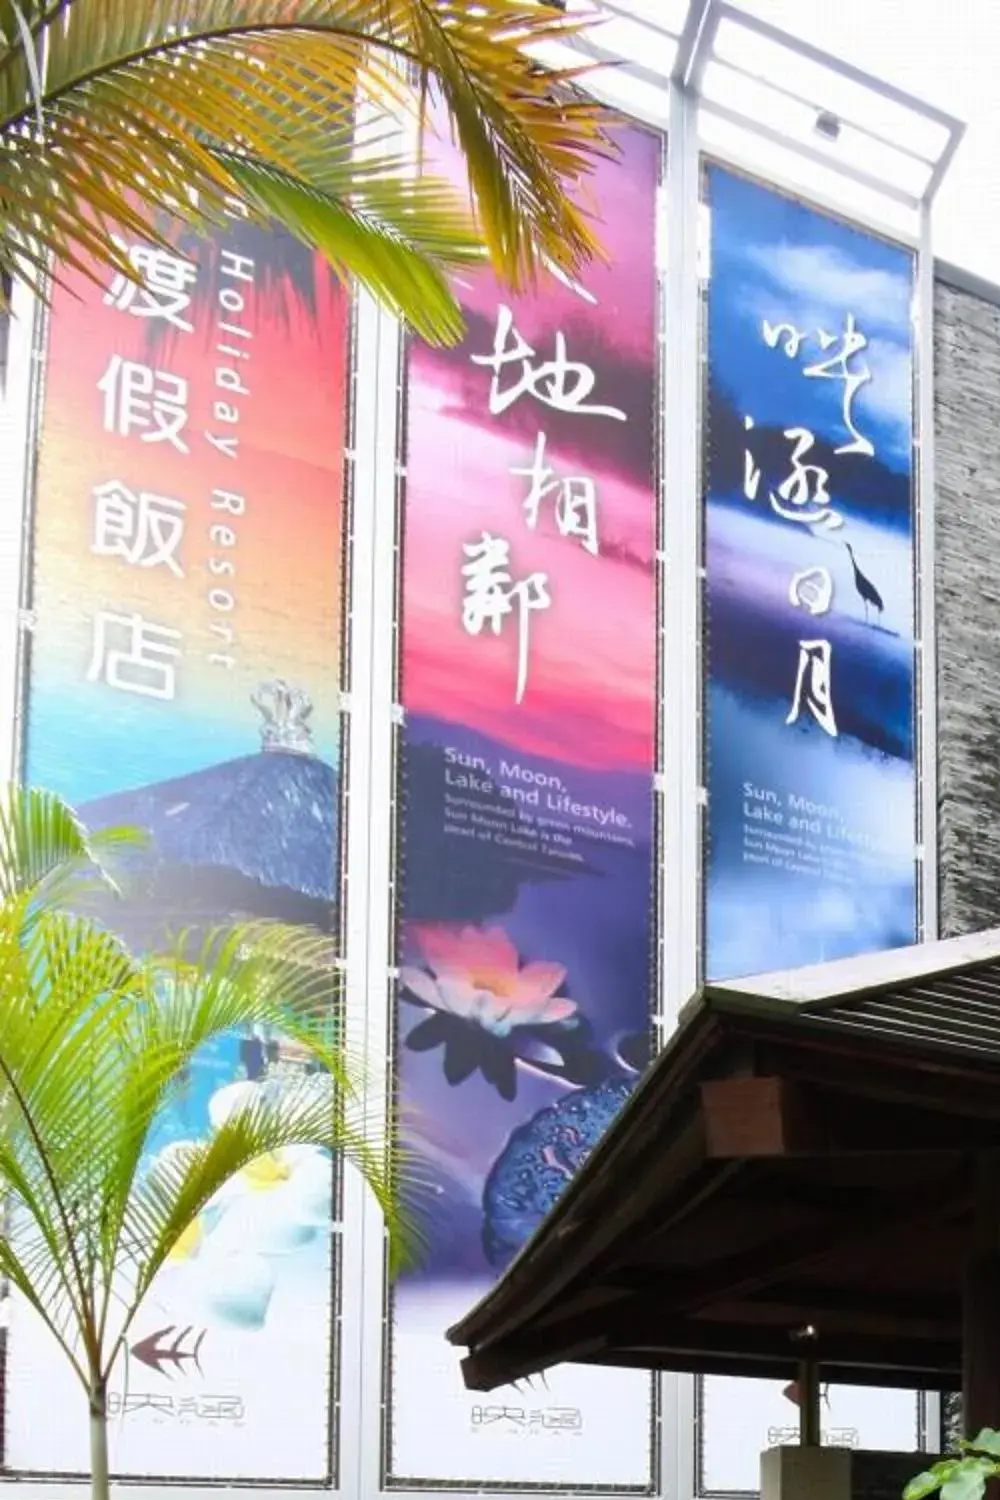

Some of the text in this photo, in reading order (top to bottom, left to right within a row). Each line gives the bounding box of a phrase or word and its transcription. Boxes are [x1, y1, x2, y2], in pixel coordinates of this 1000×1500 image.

[204, 248, 256, 461] Holiday
[456, 237, 628, 705] 地相鄰
[207, 487, 246, 669] Resort
[444, 768, 633, 829] Lake and Lifestyle.
[743, 801, 784, 825] Lake
[788, 816, 821, 835] and
